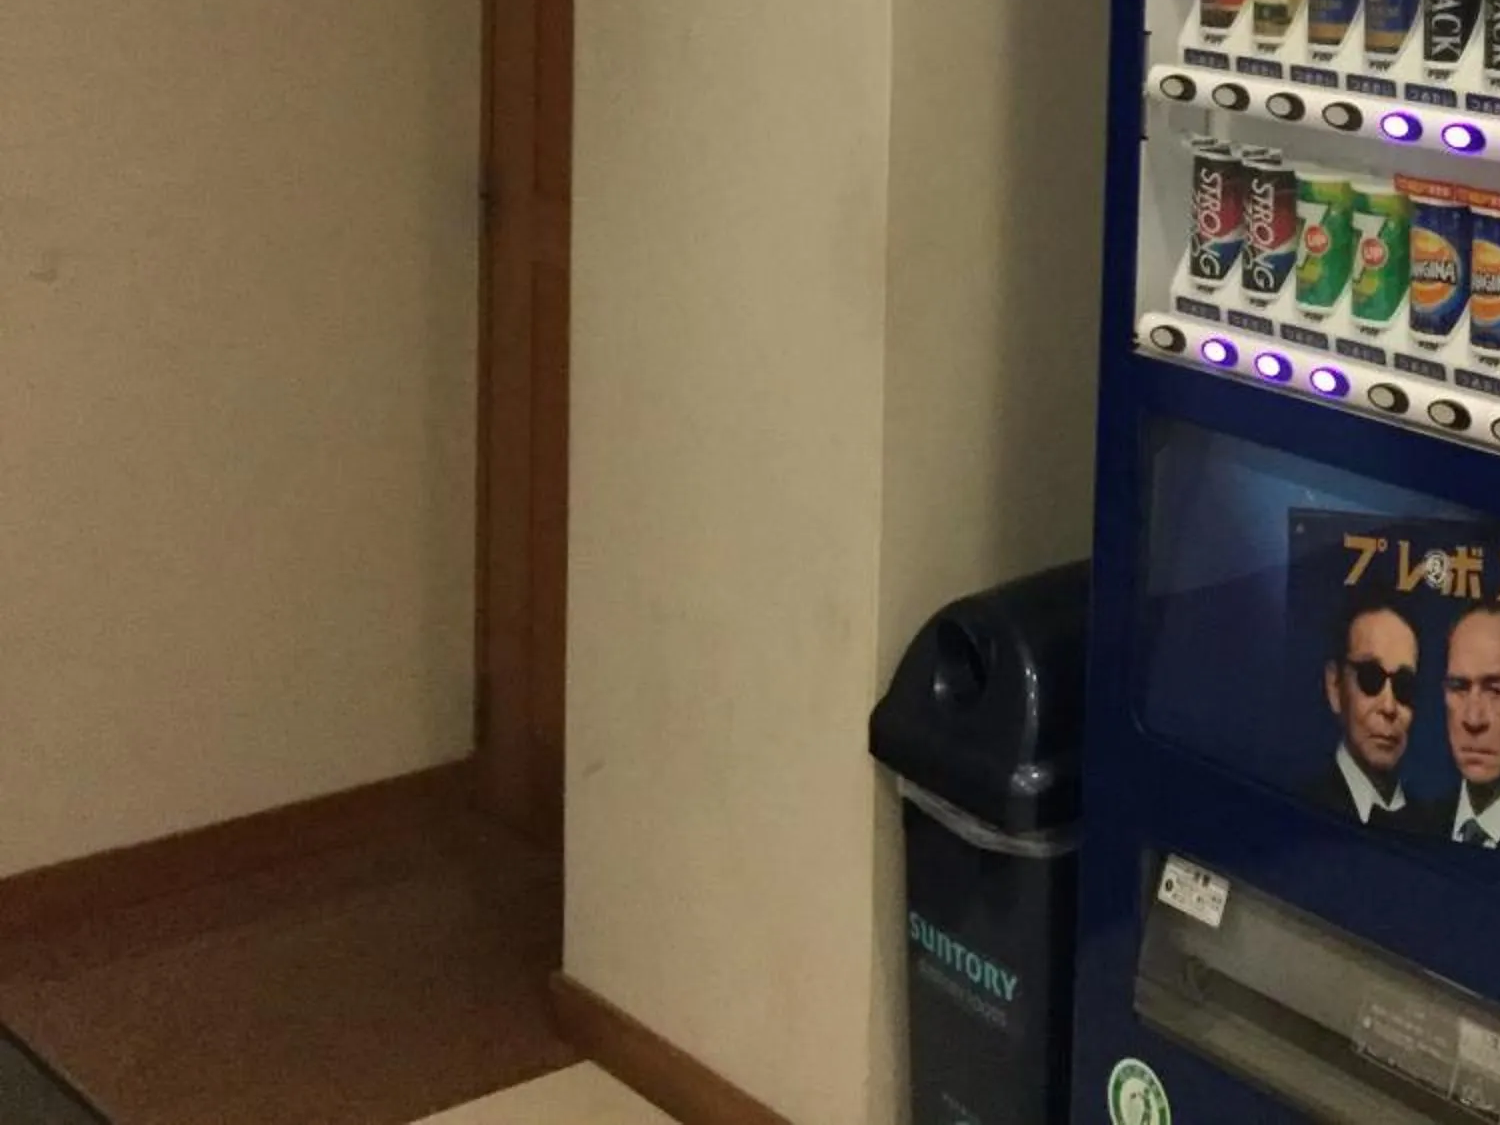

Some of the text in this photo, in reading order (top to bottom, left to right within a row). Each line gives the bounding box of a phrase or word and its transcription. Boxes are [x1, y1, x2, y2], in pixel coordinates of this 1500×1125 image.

[1199, 168, 1223, 276] STRONG
[1252, 178, 1276, 290] STRONG
[909, 911, 1018, 1002] SUNTORY
